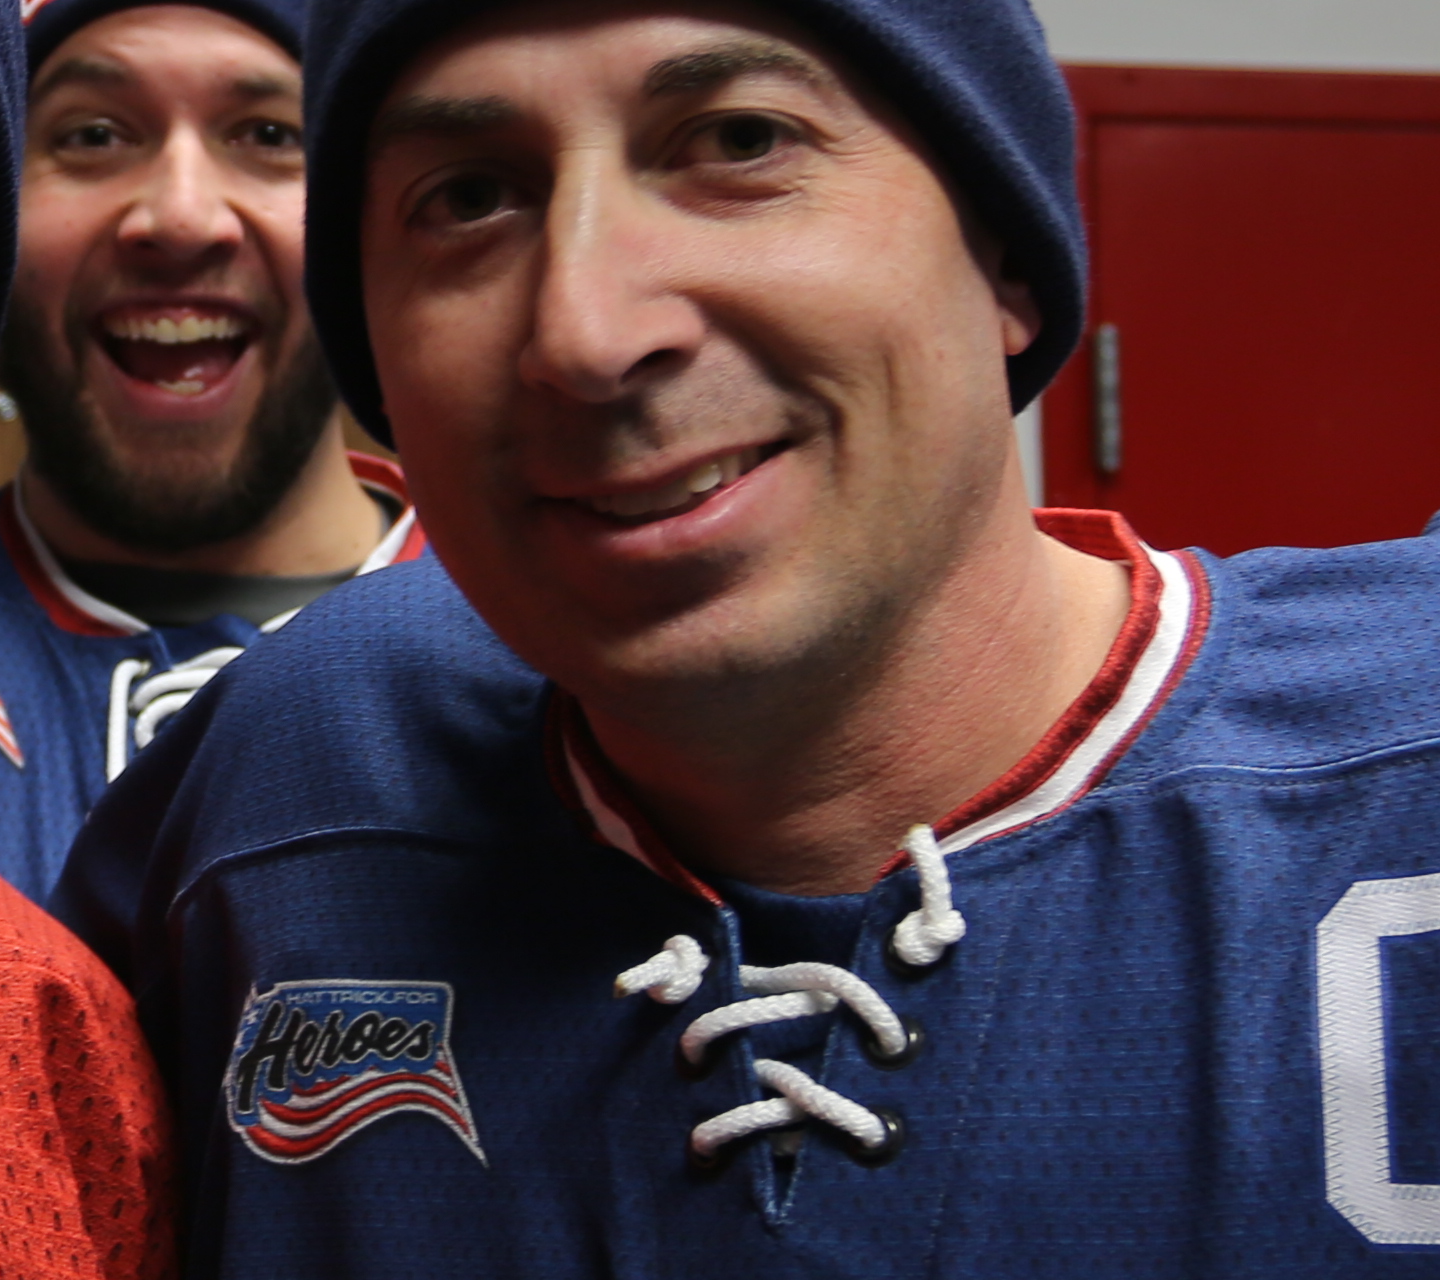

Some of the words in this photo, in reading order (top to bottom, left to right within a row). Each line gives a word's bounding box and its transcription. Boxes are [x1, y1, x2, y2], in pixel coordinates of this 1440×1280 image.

[285, 990, 323, 1005] HAT
[328, 989, 393, 1005] TRICK
[394, 990, 438, 1005] FOR
[235, 999, 436, 1115] Heroes
